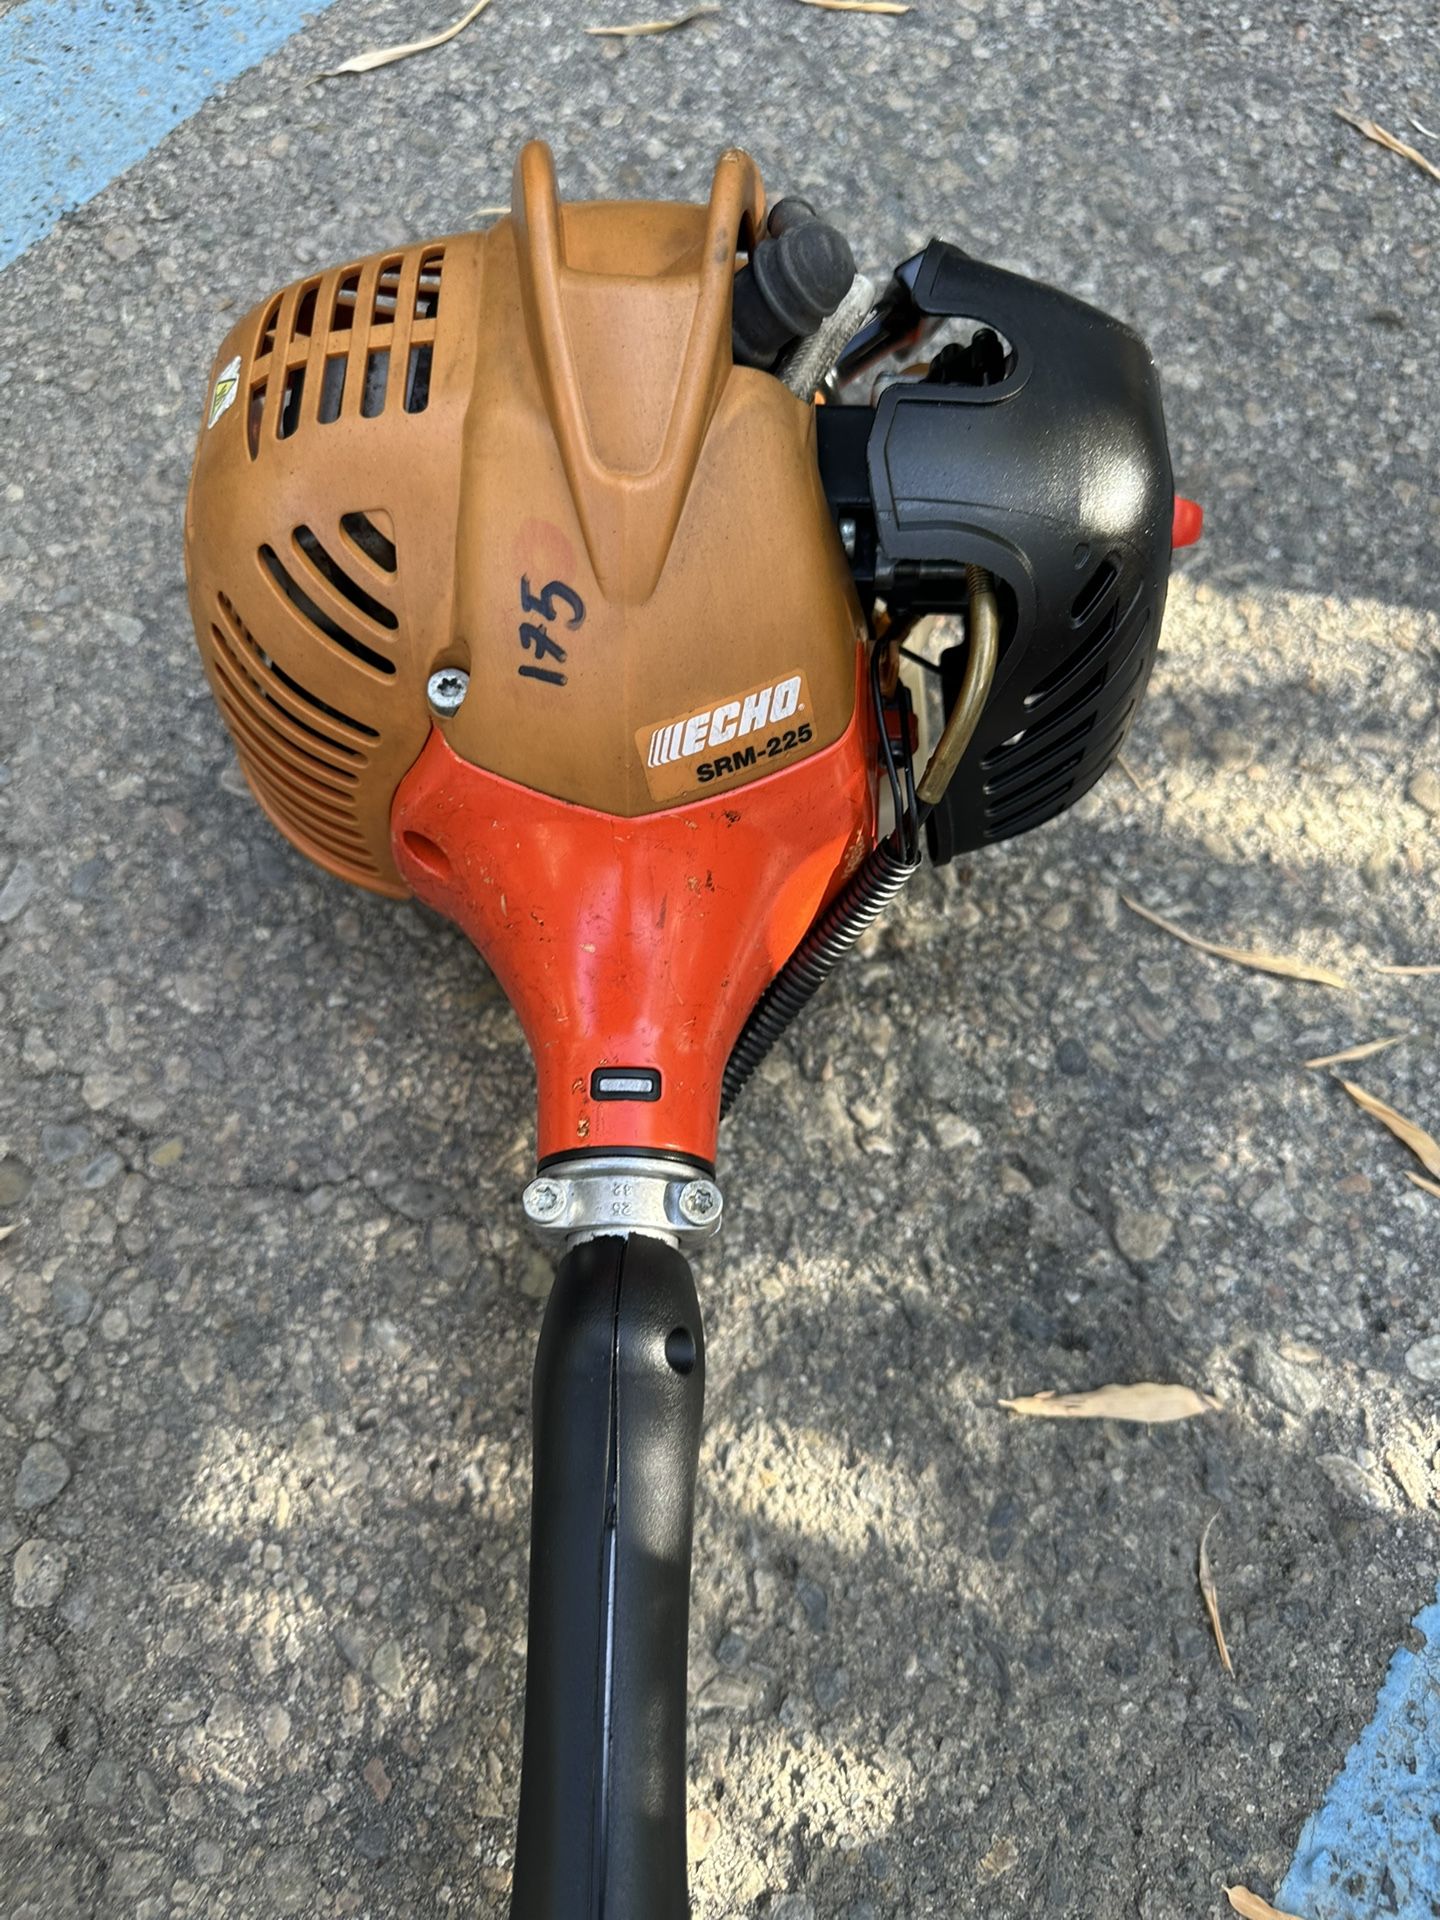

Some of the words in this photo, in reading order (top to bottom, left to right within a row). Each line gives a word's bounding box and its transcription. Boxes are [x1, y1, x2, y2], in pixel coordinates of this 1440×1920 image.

[518, 573, 586, 686] 175
[680, 675, 802, 757] ECHO
[696, 723, 813, 783] SRM-225
